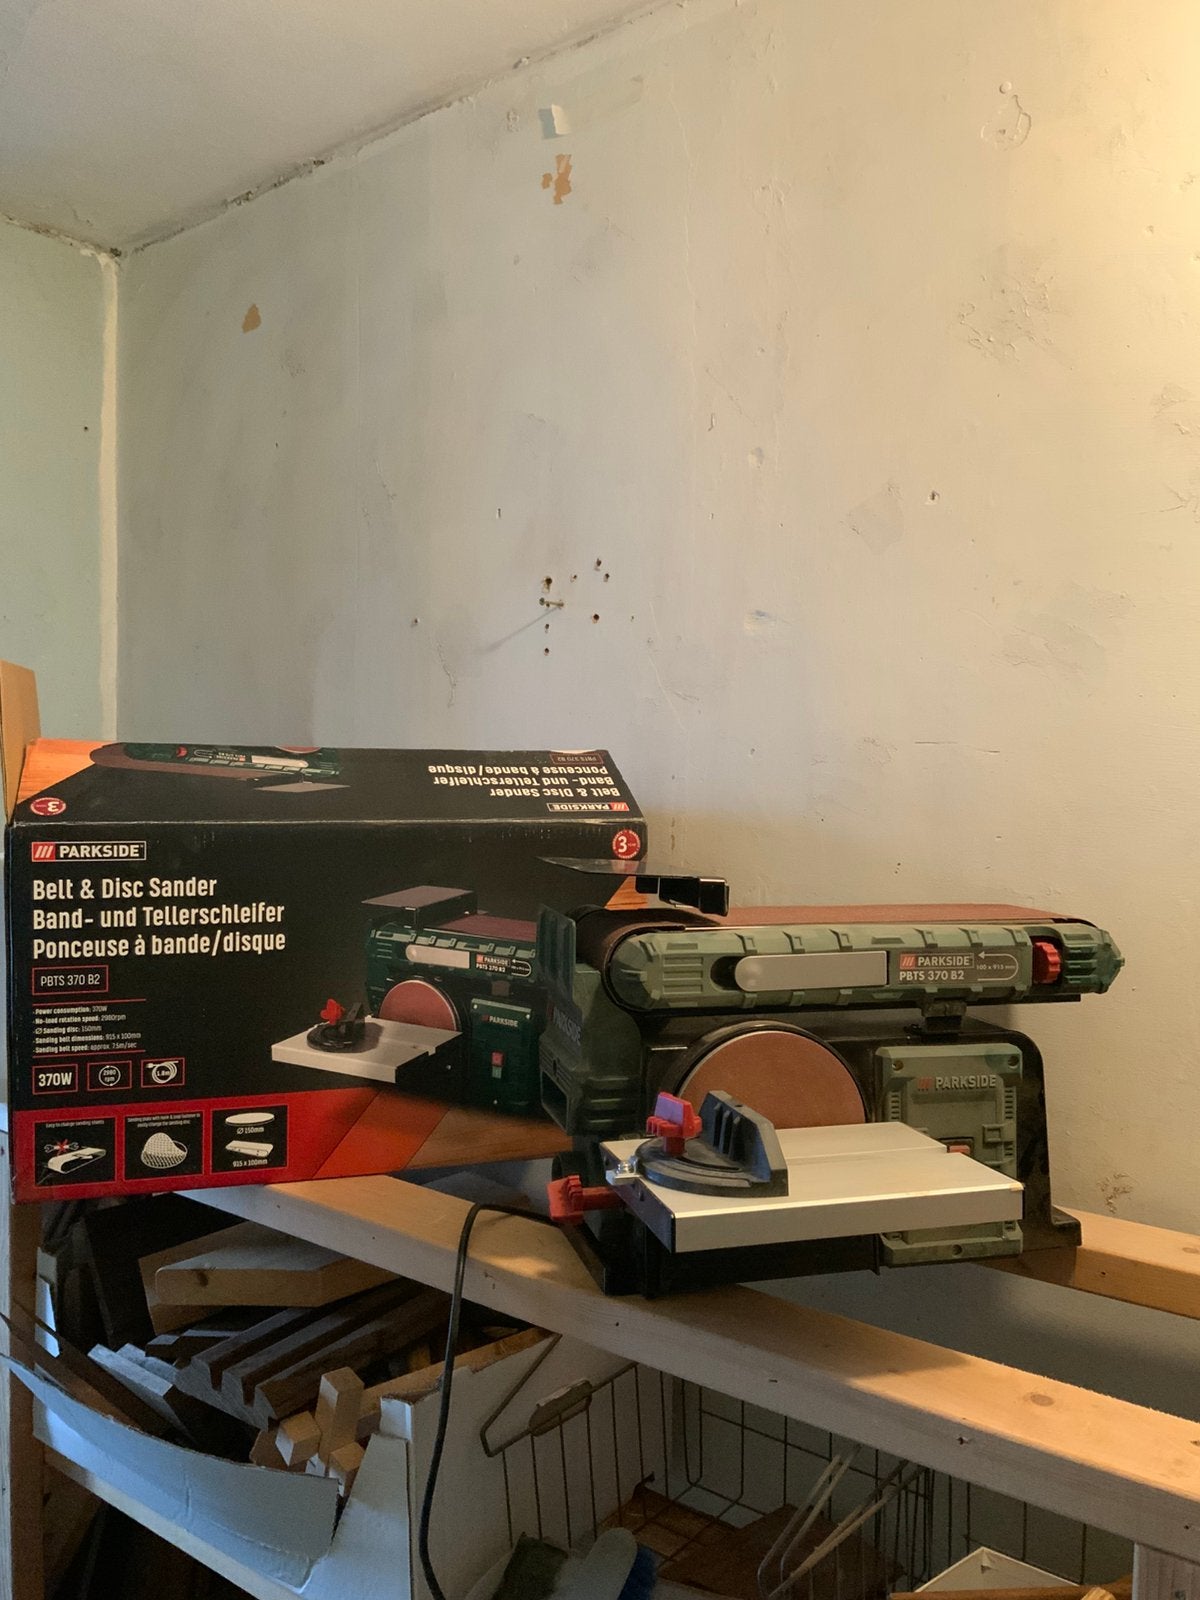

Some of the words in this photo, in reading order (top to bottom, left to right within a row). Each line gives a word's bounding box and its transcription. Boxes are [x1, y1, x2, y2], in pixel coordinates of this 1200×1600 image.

[428, 764, 529, 775] bande/disque
[530, 766, 540, 775] à
[542, 766, 609, 775] Ponceuse
[433, 776, 540, 786] Tellerschleifer
[542, 777, 569, 785] und
[572, 777, 615, 785] Band-
[490, 787, 539, 797] Sander
[542, 788, 574, 797] Disc
[578, 788, 588, 797] &
[591, 788, 621, 797] Belt
[47, 801, 60, 812] 3
[552, 803, 610, 811] PARKSIDE
[618, 836, 628, 853] 3
[59, 845, 140, 858] PARKSIDE
[33, 879, 73, 900] Belt
[80, 879, 95, 899] &
[102, 877, 143, 898] Disc
[150, 876, 217, 897] Sander
[33, 908, 94, 930] Band-
[100, 907, 137, 928] und
[142, 902, 285, 926] Tellerschleifer
[33, 938, 129, 959] Ponceuse
[134, 934, 146, 956] à
[151, 930, 286, 957] bande/disque
[918, 956, 970, 967] PARKSIDE
[40, 975, 65, 987] PBTS
[67, 974, 86, 986] 370
[88, 973, 101, 985] B2
[900, 971, 925, 981] PBTS
[927, 971, 949, 980] 370
[951, 970, 965, 980] B2
[489, 1016, 518, 1028] PARKSIDE
[38, 1072, 72, 1087] 370W
[935, 1074, 997, 1089] PARKSIDE
[245, 1126, 265, 1134] 150mm
